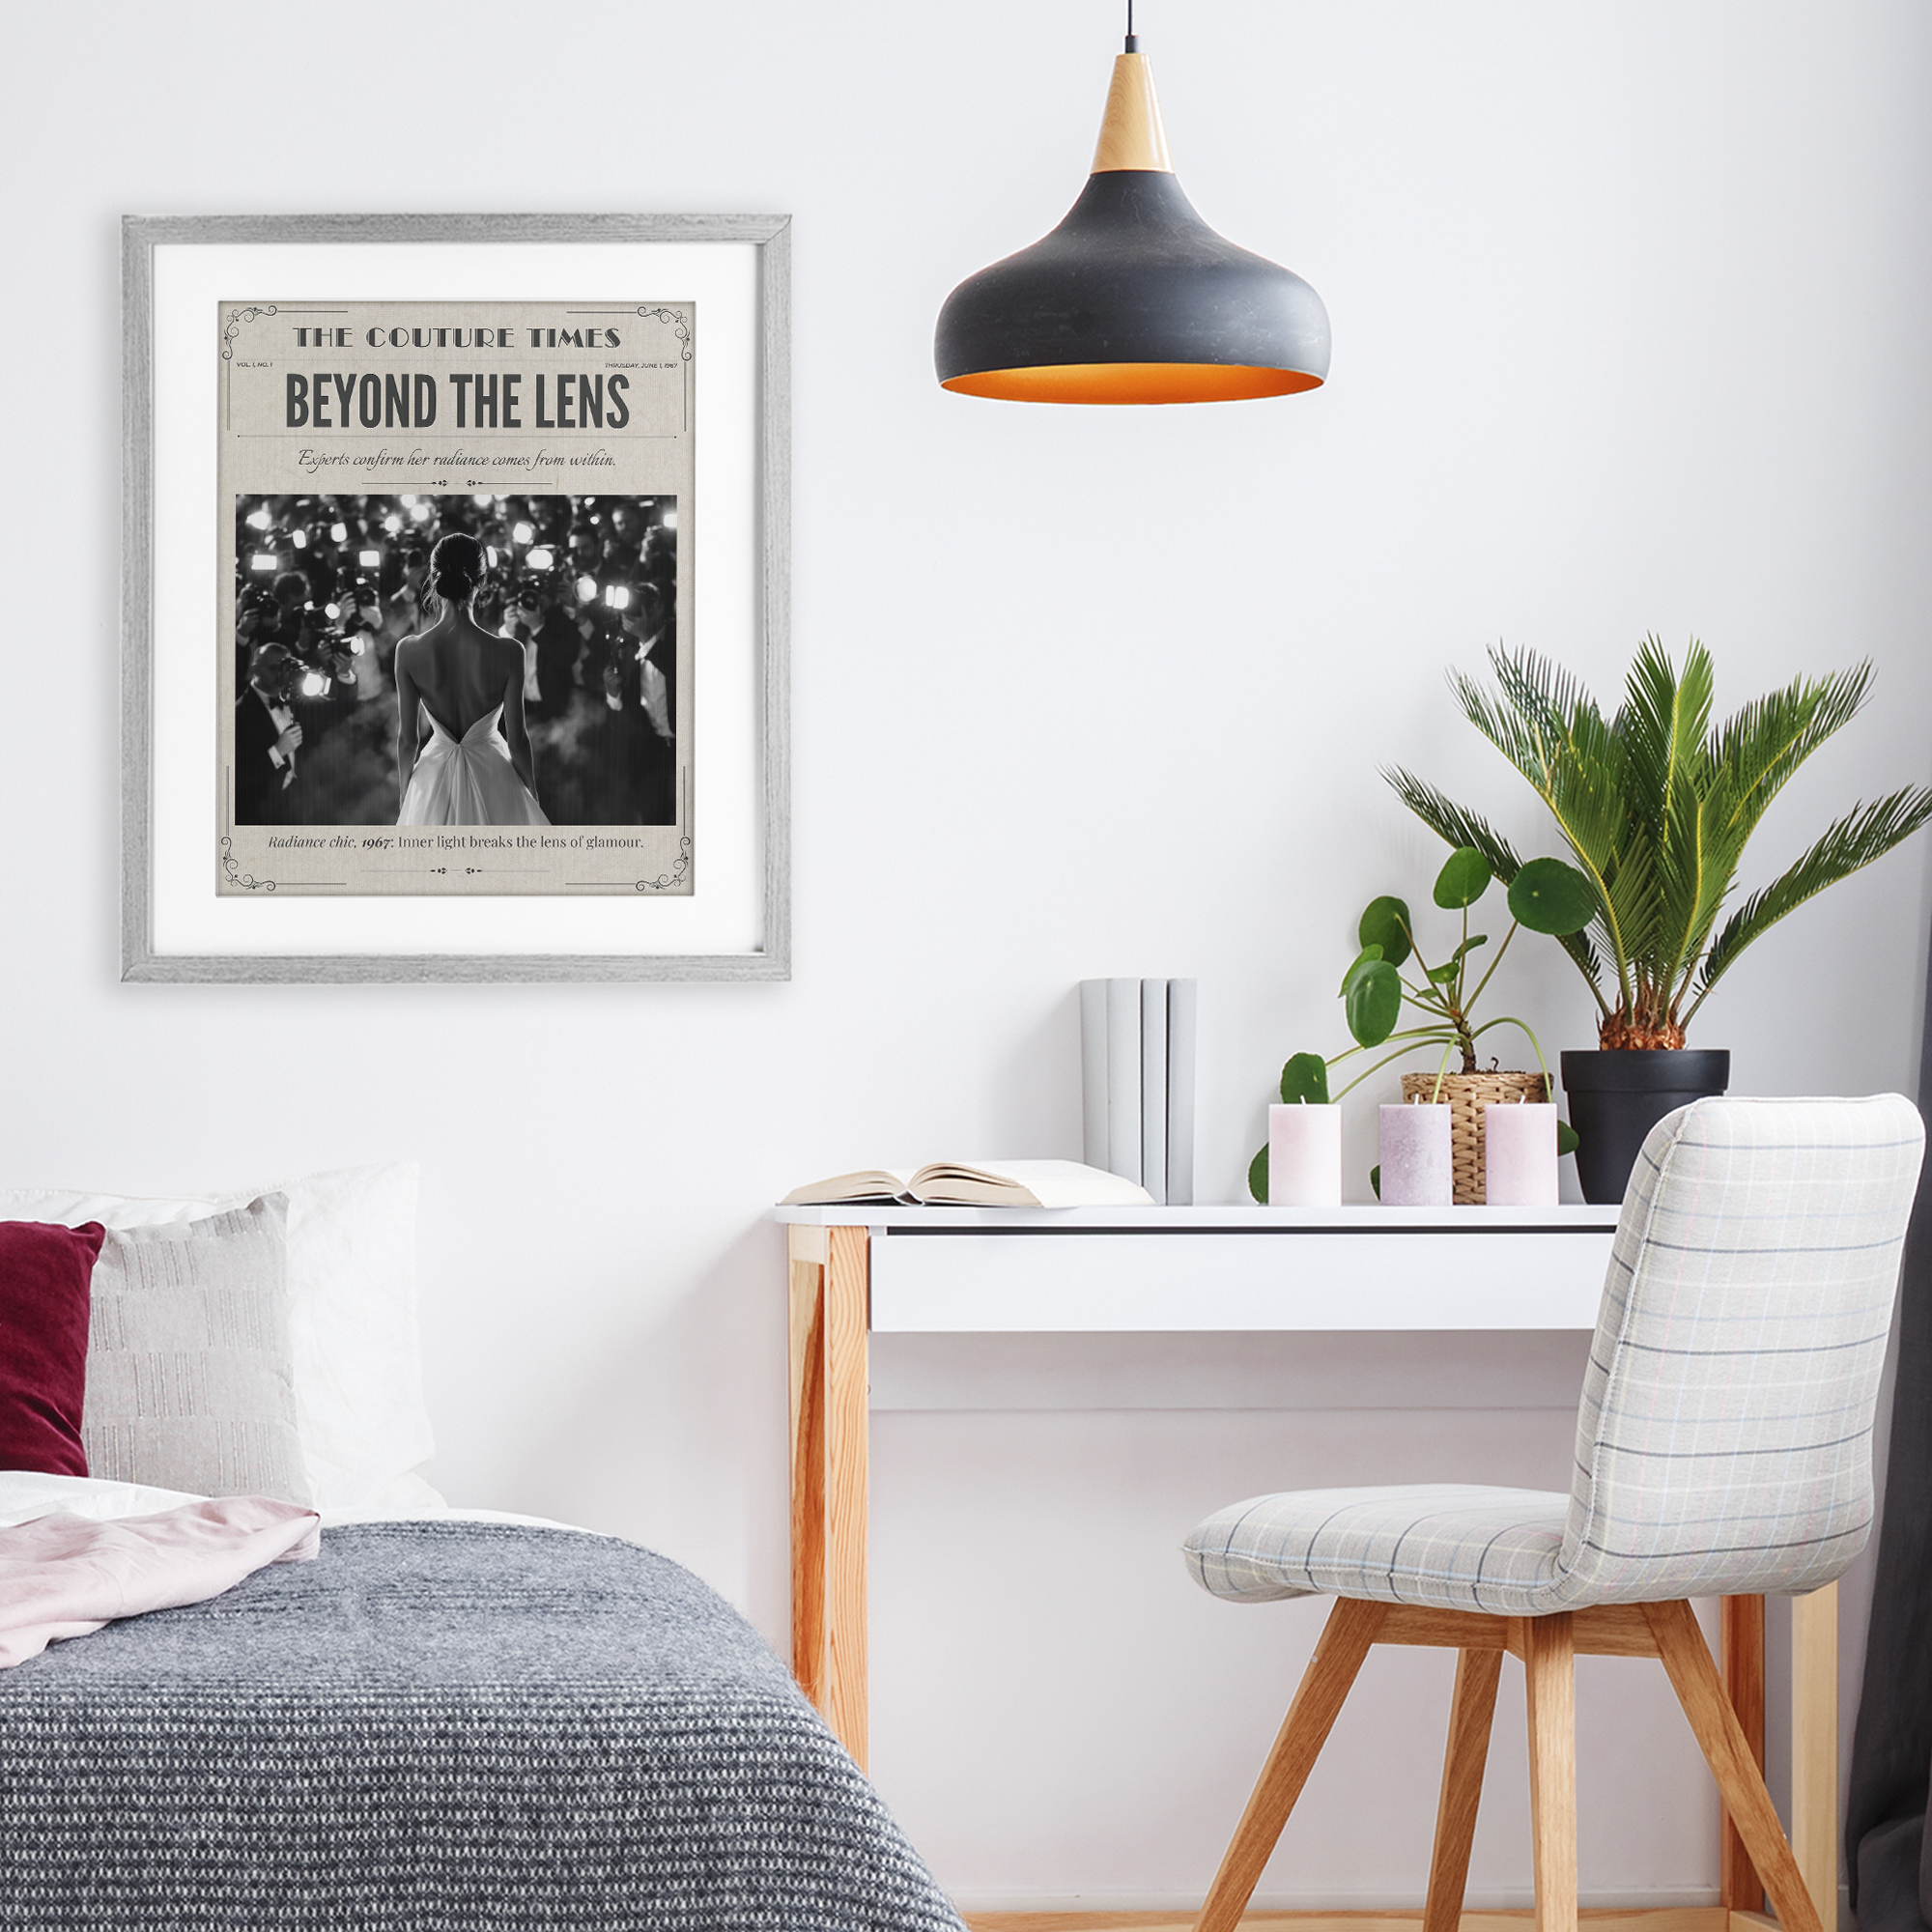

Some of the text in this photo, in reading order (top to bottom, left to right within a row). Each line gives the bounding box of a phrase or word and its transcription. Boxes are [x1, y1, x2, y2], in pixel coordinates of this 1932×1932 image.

[292, 326, 621, 349] THE COUTURE TIMES
[286, 373, 630, 429] BEYOND THE LENS
[298, 448, 616, 474] Experts confirm her radiance comes from within.
[268, 835, 327, 849] Radiance
[361, 837, 395, 850] 1967:
[398, 836, 435, 849] Inner
[437, 835, 466, 851] light
[469, 835, 513, 849] breaks
[516, 835, 537, 849] the
[540, 835, 567, 849] lens
[570, 835, 584, 849] of
[585, 835, 644, 851] glamour.
